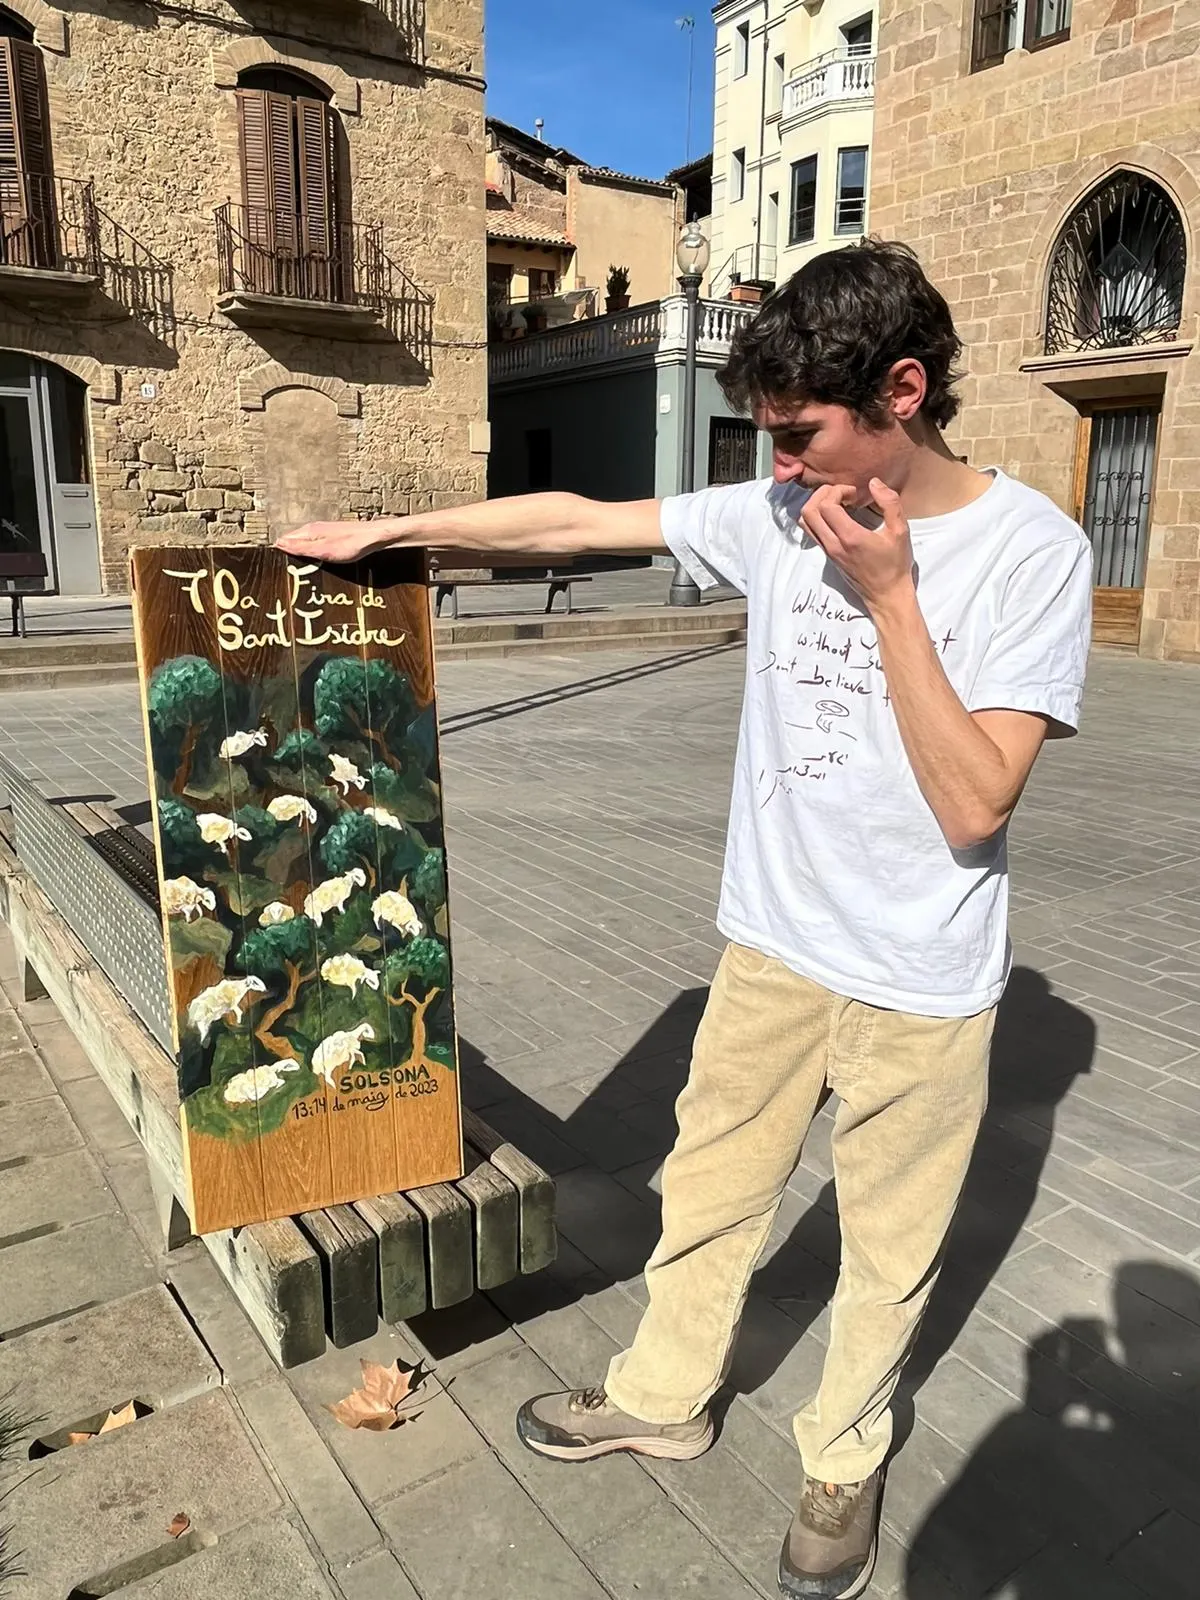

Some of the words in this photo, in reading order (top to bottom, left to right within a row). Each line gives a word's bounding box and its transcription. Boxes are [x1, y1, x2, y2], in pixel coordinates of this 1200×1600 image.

[287, 563, 354, 607] Fira
[361, 567, 387, 609] de
[791, 589, 869, 622] Whatever
[217, 599, 293, 651] Sant
[294, 607, 406, 647] Isidre
[797, 631, 852, 663] without
[796, 665, 873, 695] believe
[332, 1100, 346, 1112] de
[348, 1091, 390, 1112] maig
[395, 1086, 408, 1099] de
[409, 1079, 439, 1097] 2023
[339, 1064, 431, 1094] SOLSONA
